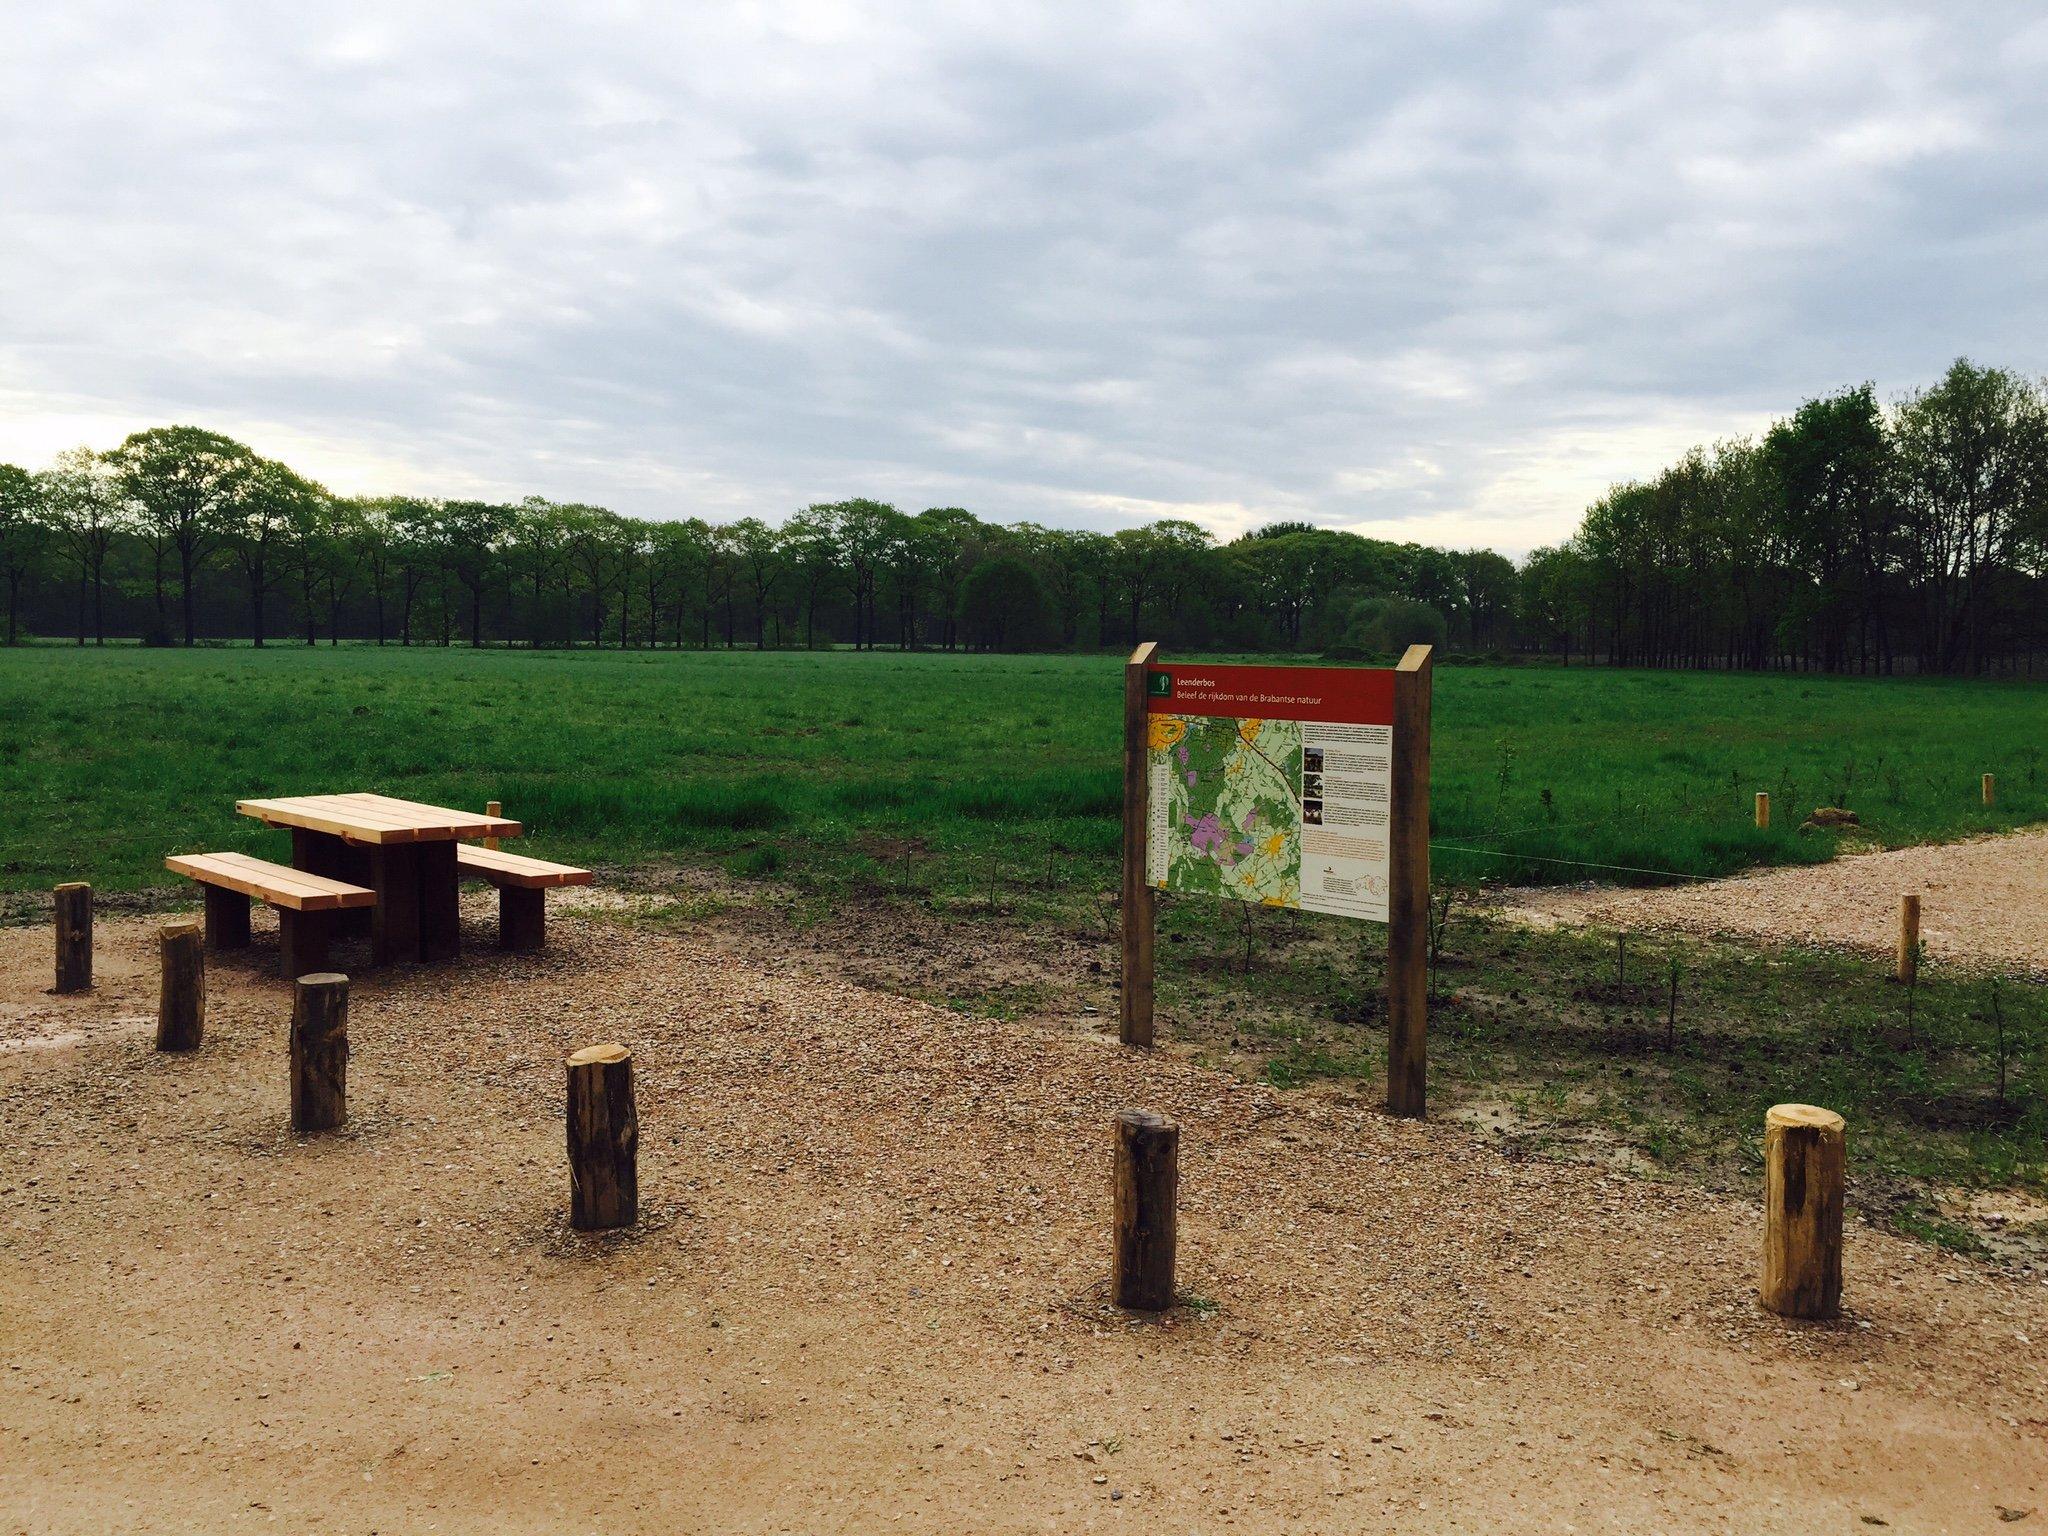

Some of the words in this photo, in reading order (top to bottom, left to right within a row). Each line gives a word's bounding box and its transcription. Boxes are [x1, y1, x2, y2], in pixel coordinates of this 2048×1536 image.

[1177, 690, 1198, 699] Beleef
[1198, 691, 1207, 700] de
[1208, 692, 1234, 703] rijkdom
[1249, 693, 1259, 702] de
[1260, 694, 1296, 704] Brabantse
[1296, 696, 1322, 705] natuur
